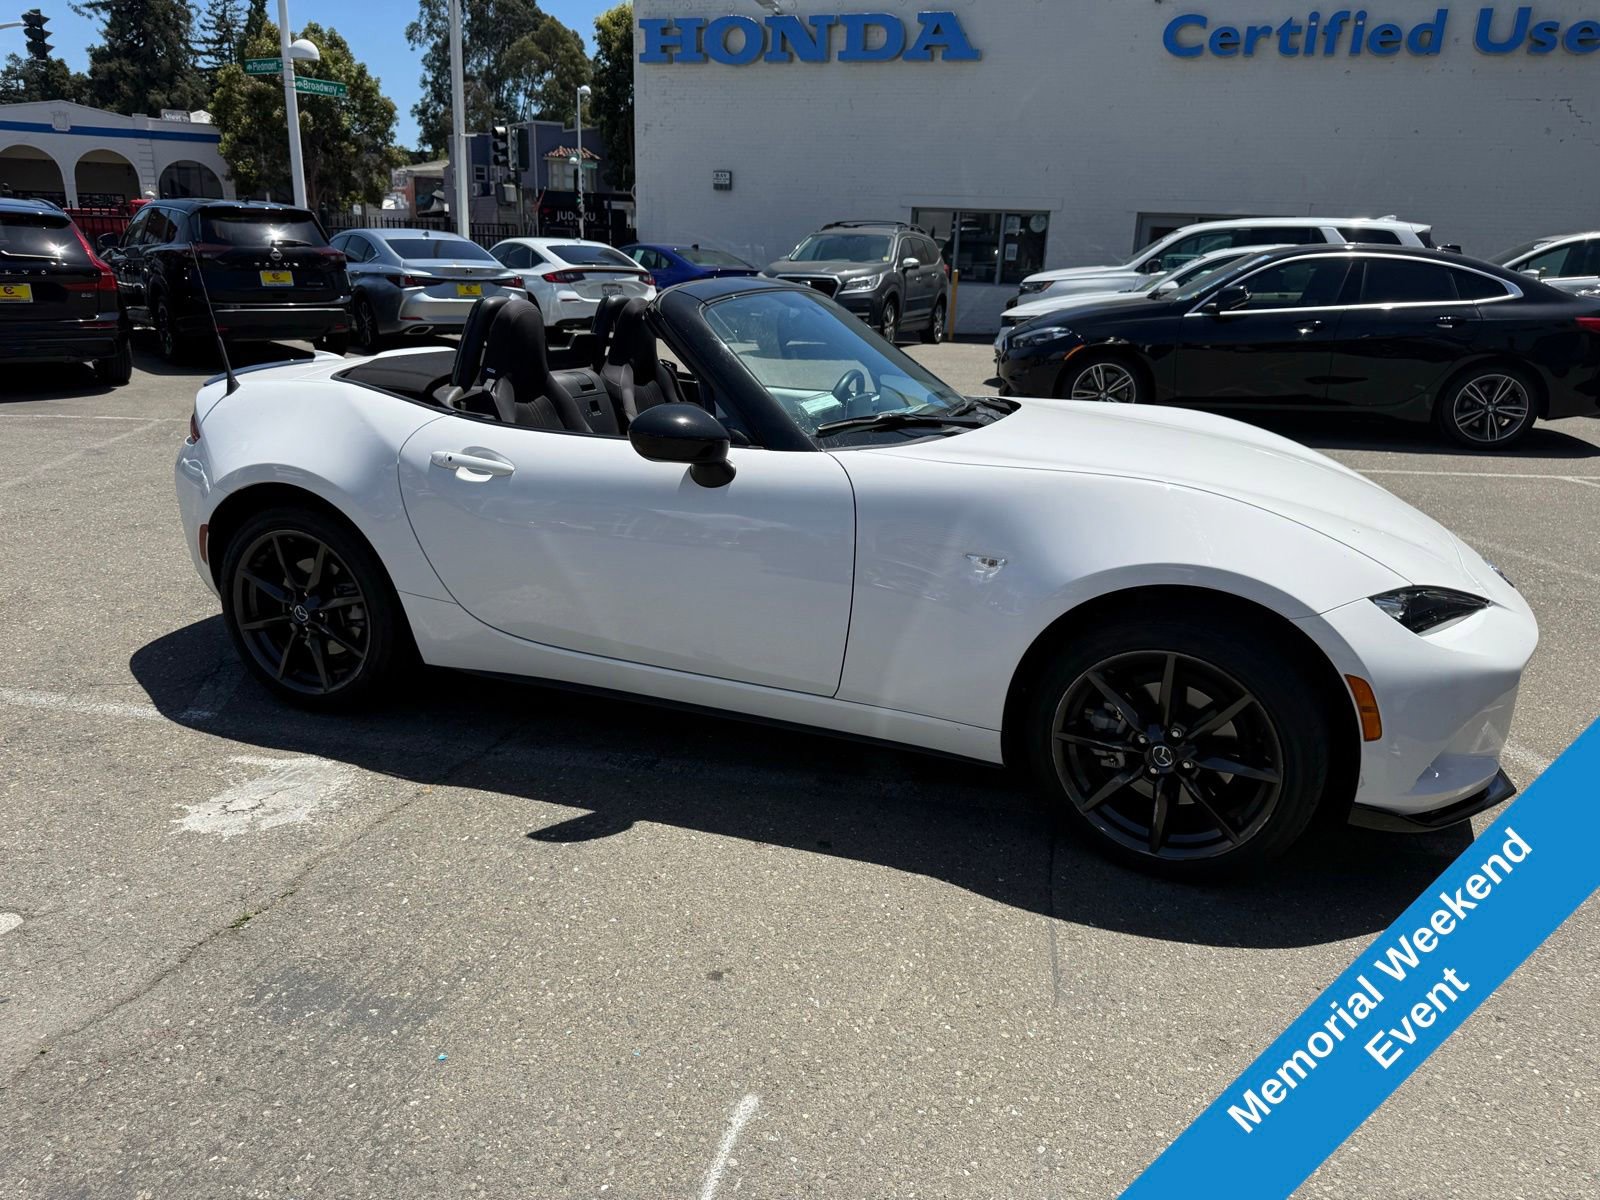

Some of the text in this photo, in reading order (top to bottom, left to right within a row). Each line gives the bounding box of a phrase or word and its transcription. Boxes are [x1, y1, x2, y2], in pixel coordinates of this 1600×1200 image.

[638, 11, 981, 65] HONDA
[1162, 7, 1450, 57] Certified
[252, 61, 278, 71] Piedmont
[303, 79, 338, 96] Broadway
